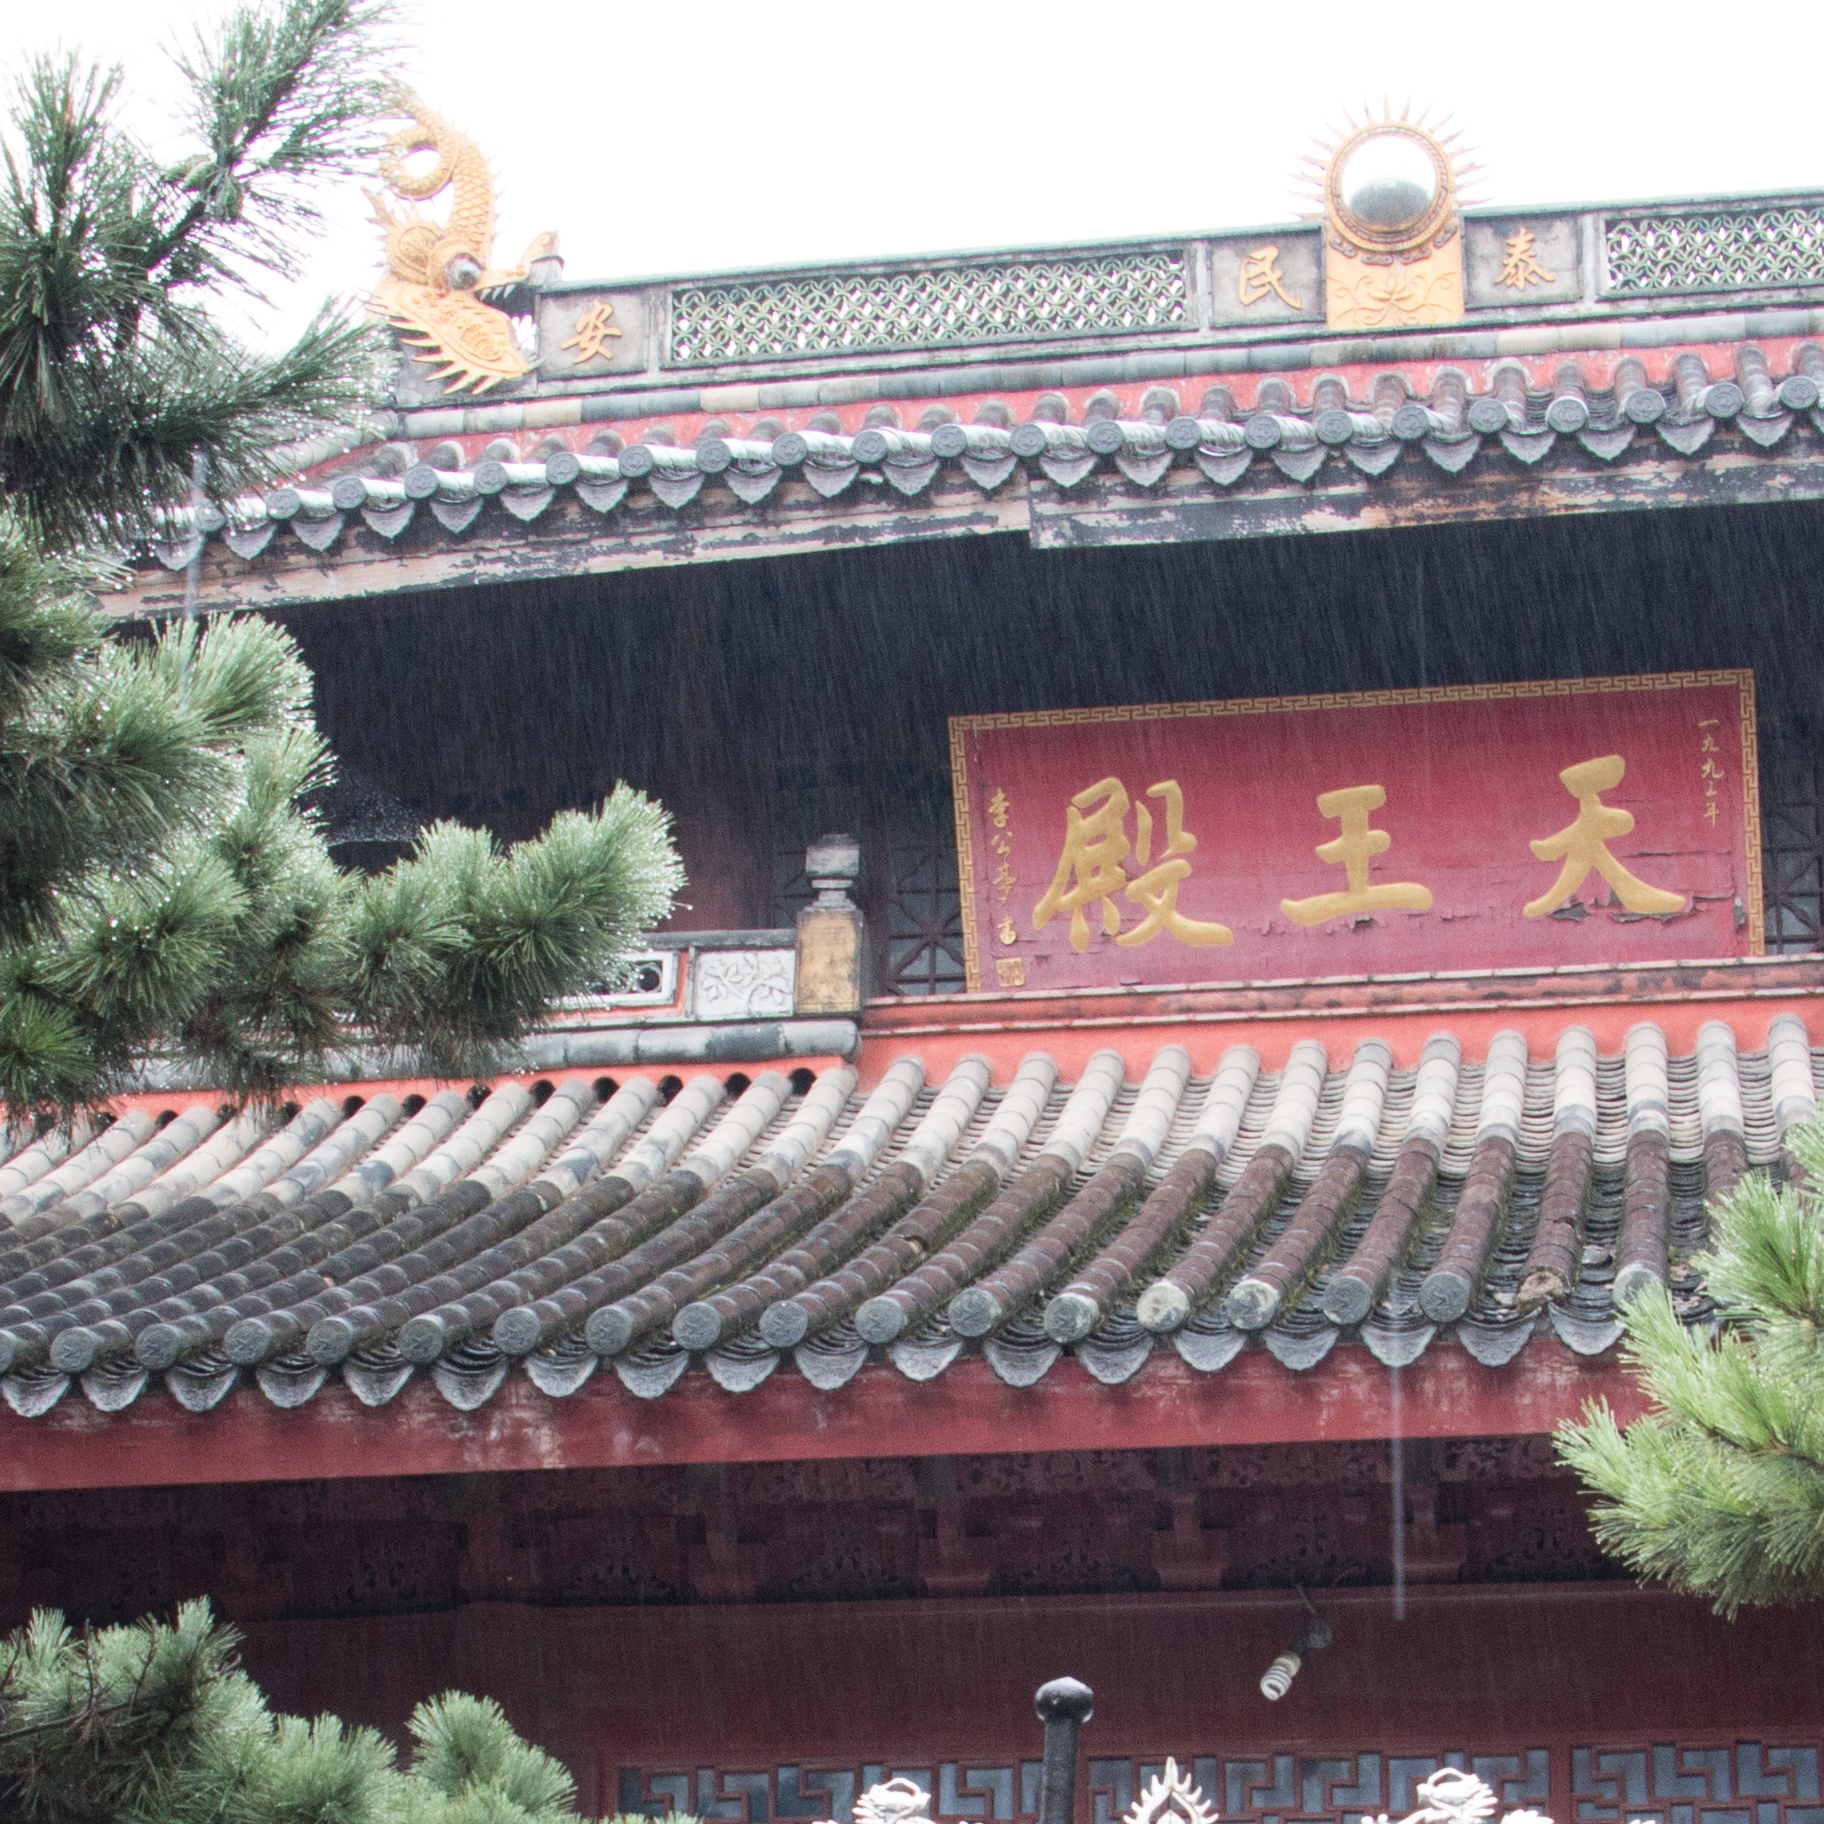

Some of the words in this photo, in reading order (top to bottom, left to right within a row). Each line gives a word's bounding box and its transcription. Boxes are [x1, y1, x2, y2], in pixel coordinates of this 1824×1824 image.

[1238, 244, 1302, 311] 民
[1494, 226, 1556, 291] 泰
[560, 299, 622, 365] 安
[1031, 753, 1687, 954] 天王殿
